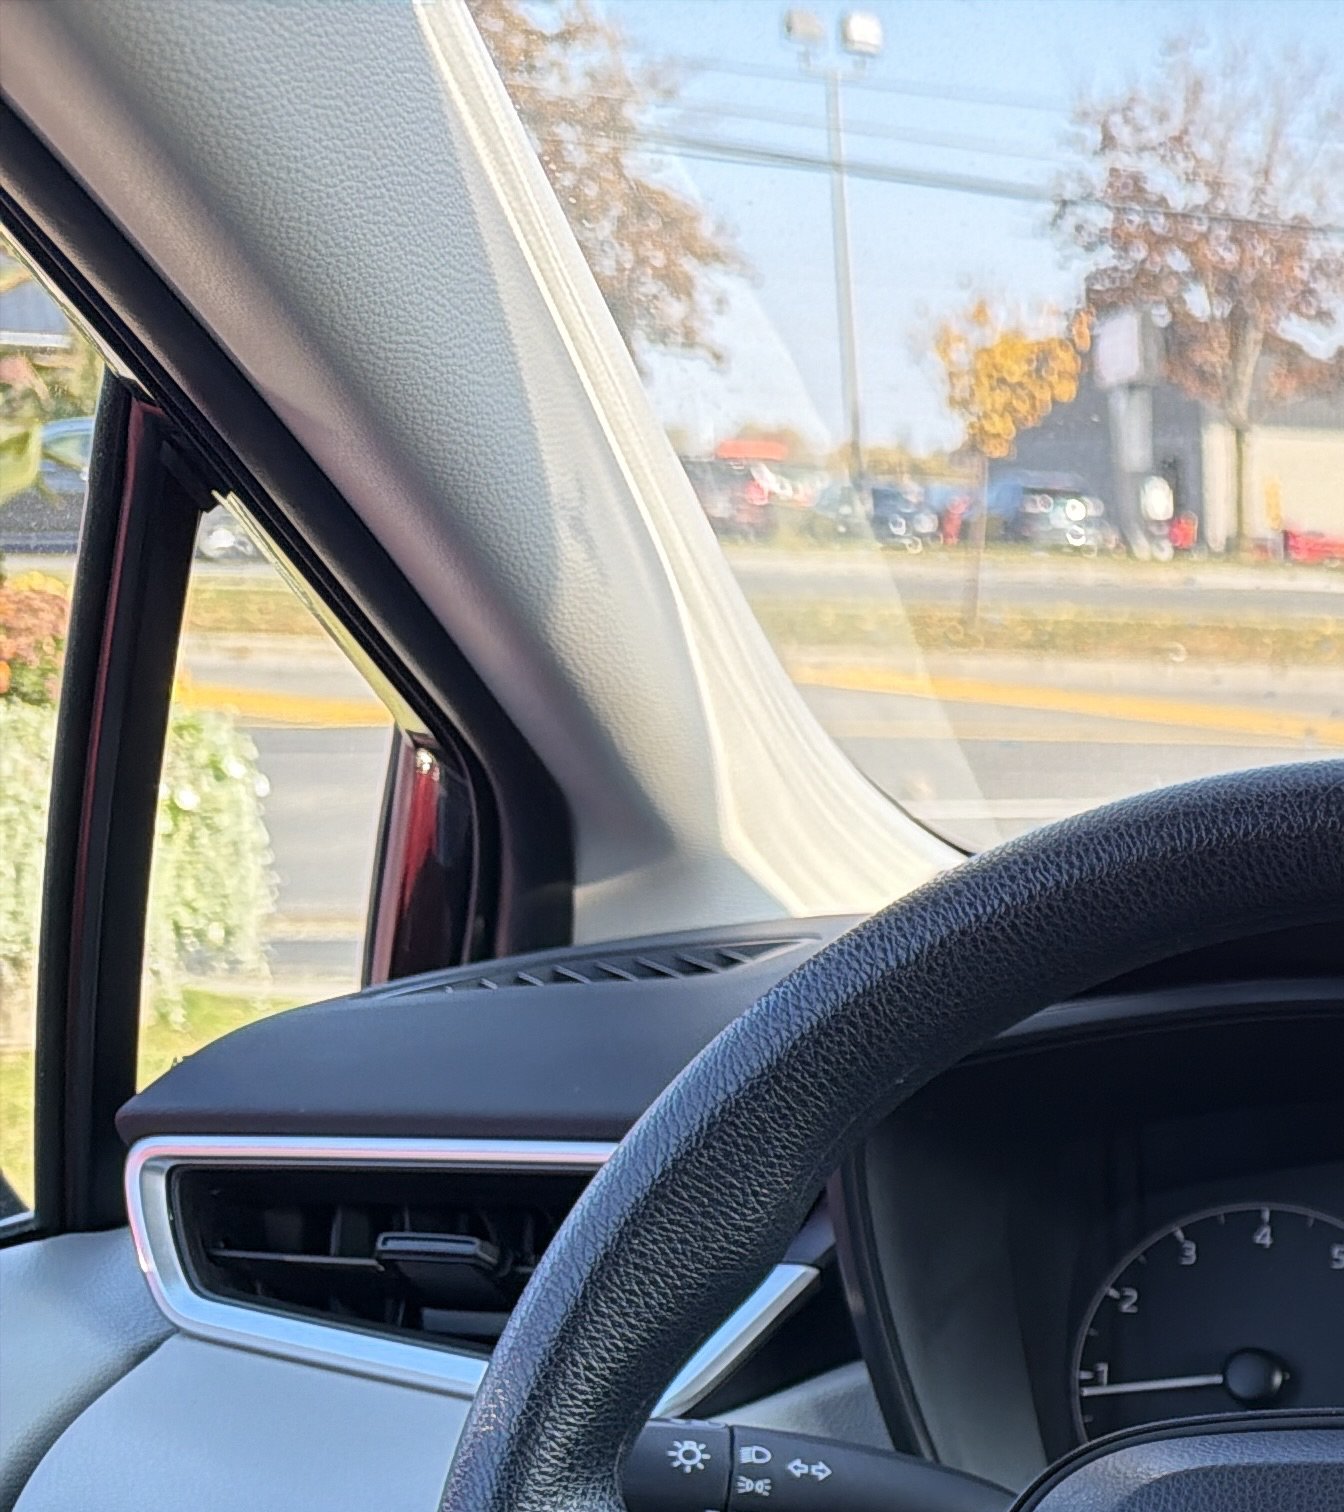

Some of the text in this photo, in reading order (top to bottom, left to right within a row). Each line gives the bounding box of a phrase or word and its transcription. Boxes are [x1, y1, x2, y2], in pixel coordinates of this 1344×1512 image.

[1252, 1224, 1273, 1249] 4
[1177, 1239, 1197, 1265] 3
[1118, 1286, 1139, 1314] 2
